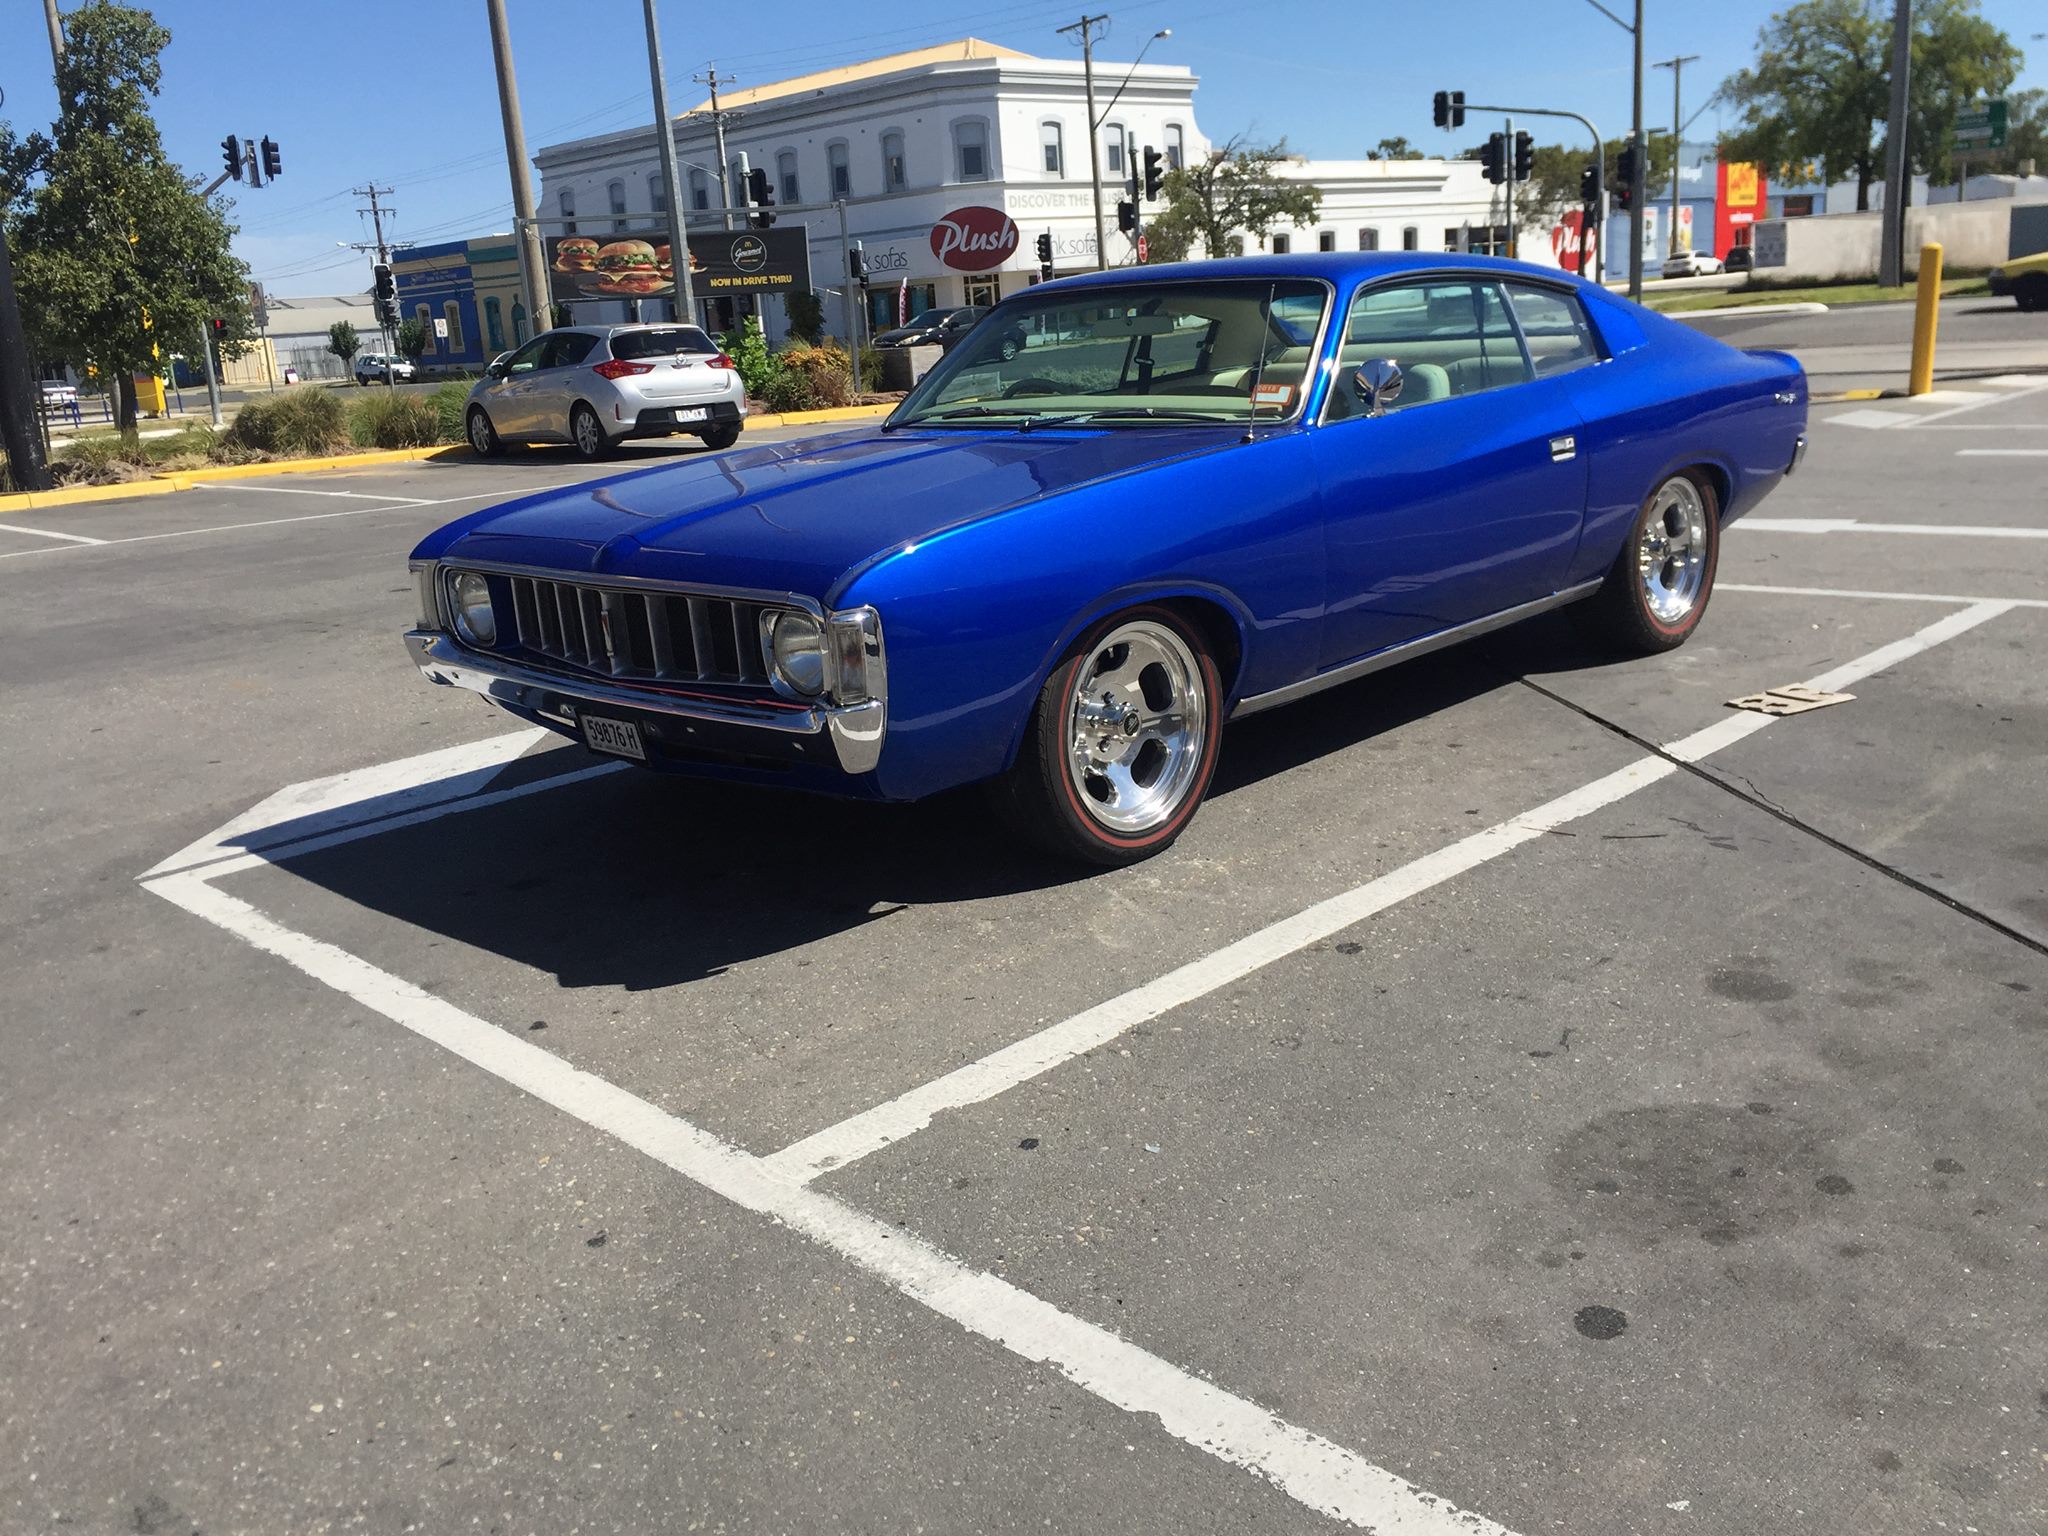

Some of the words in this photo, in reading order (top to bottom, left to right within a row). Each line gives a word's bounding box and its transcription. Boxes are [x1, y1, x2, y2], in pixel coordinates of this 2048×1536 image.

[1009, 194, 1066, 208] DISCOVER
[1068, 193, 1089, 207] THE
[935, 216, 1015, 262] Plush
[1069, 232, 1098, 254] sofa
[874, 246, 908, 270] sofas
[710, 278, 731, 287] NOW
[732, 277, 742, 286] IN
[743, 275, 768, 286] DRIVE
[769, 274, 792, 285] THRU
